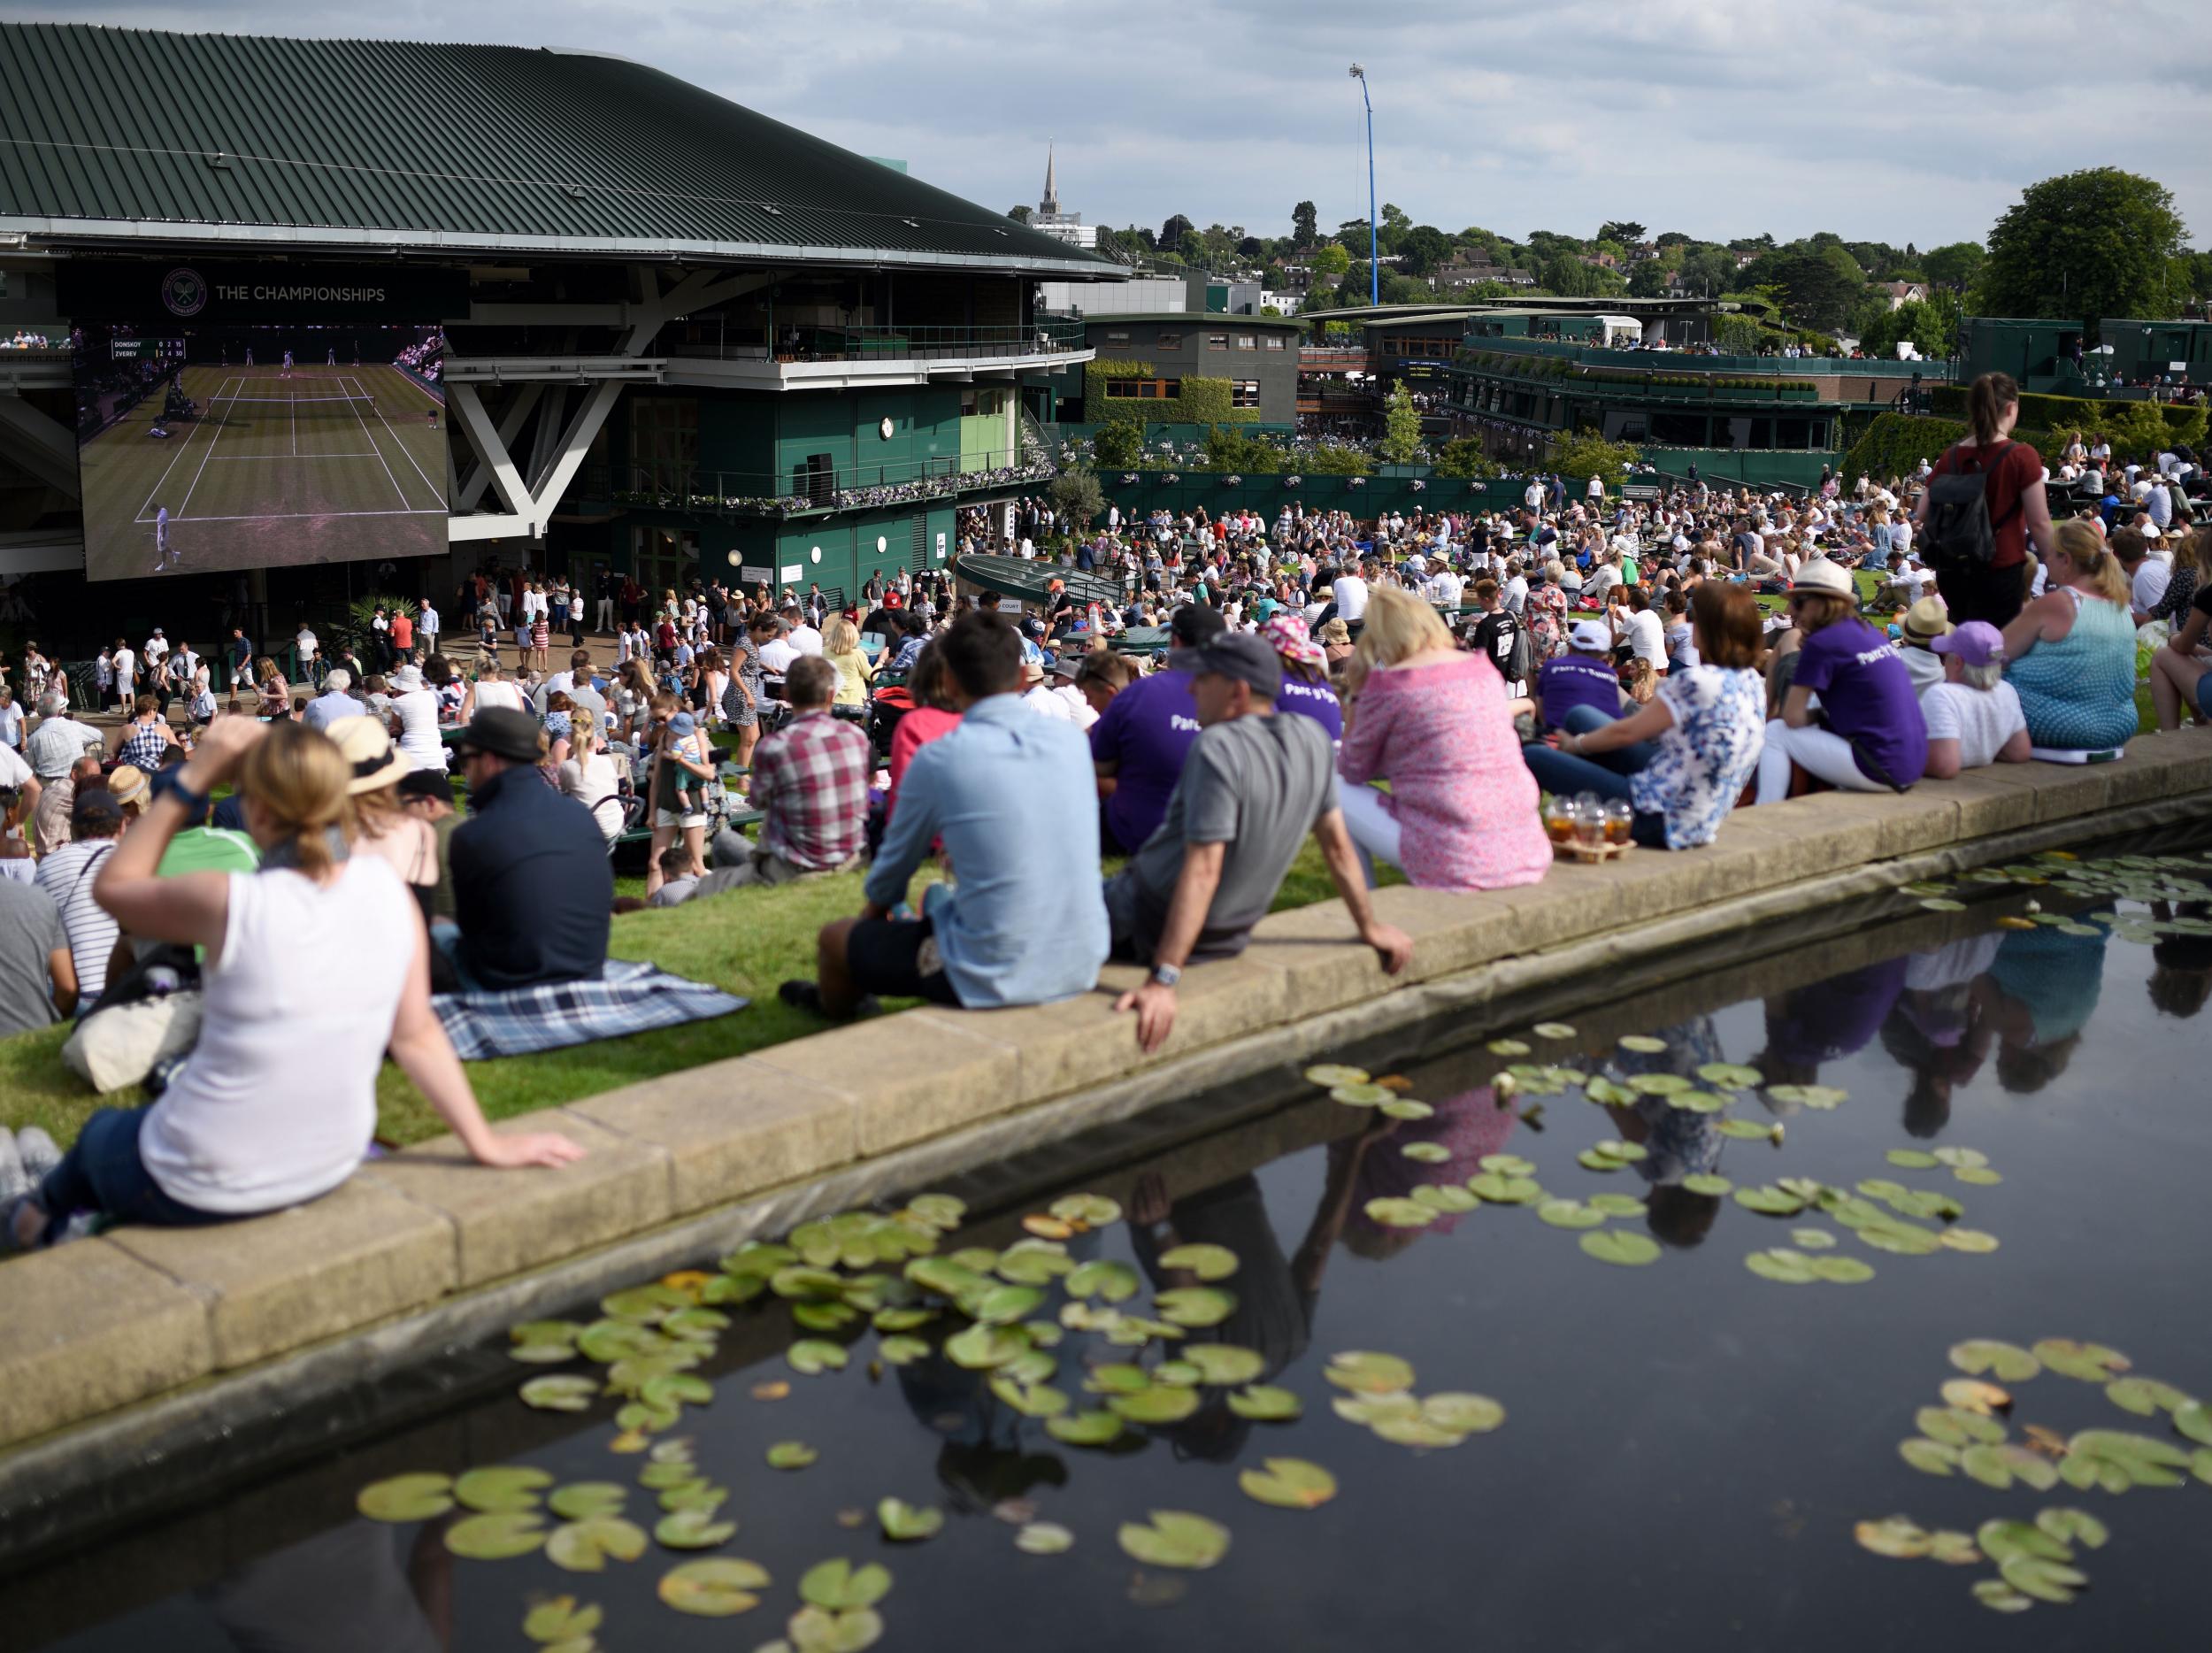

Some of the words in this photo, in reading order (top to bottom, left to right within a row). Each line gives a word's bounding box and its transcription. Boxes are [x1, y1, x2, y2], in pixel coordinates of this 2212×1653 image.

[216, 285, 249, 300] THE
[254, 286, 386, 302] CHAMPIONSHIPS
[1284, 683, 1312, 696] Parc
